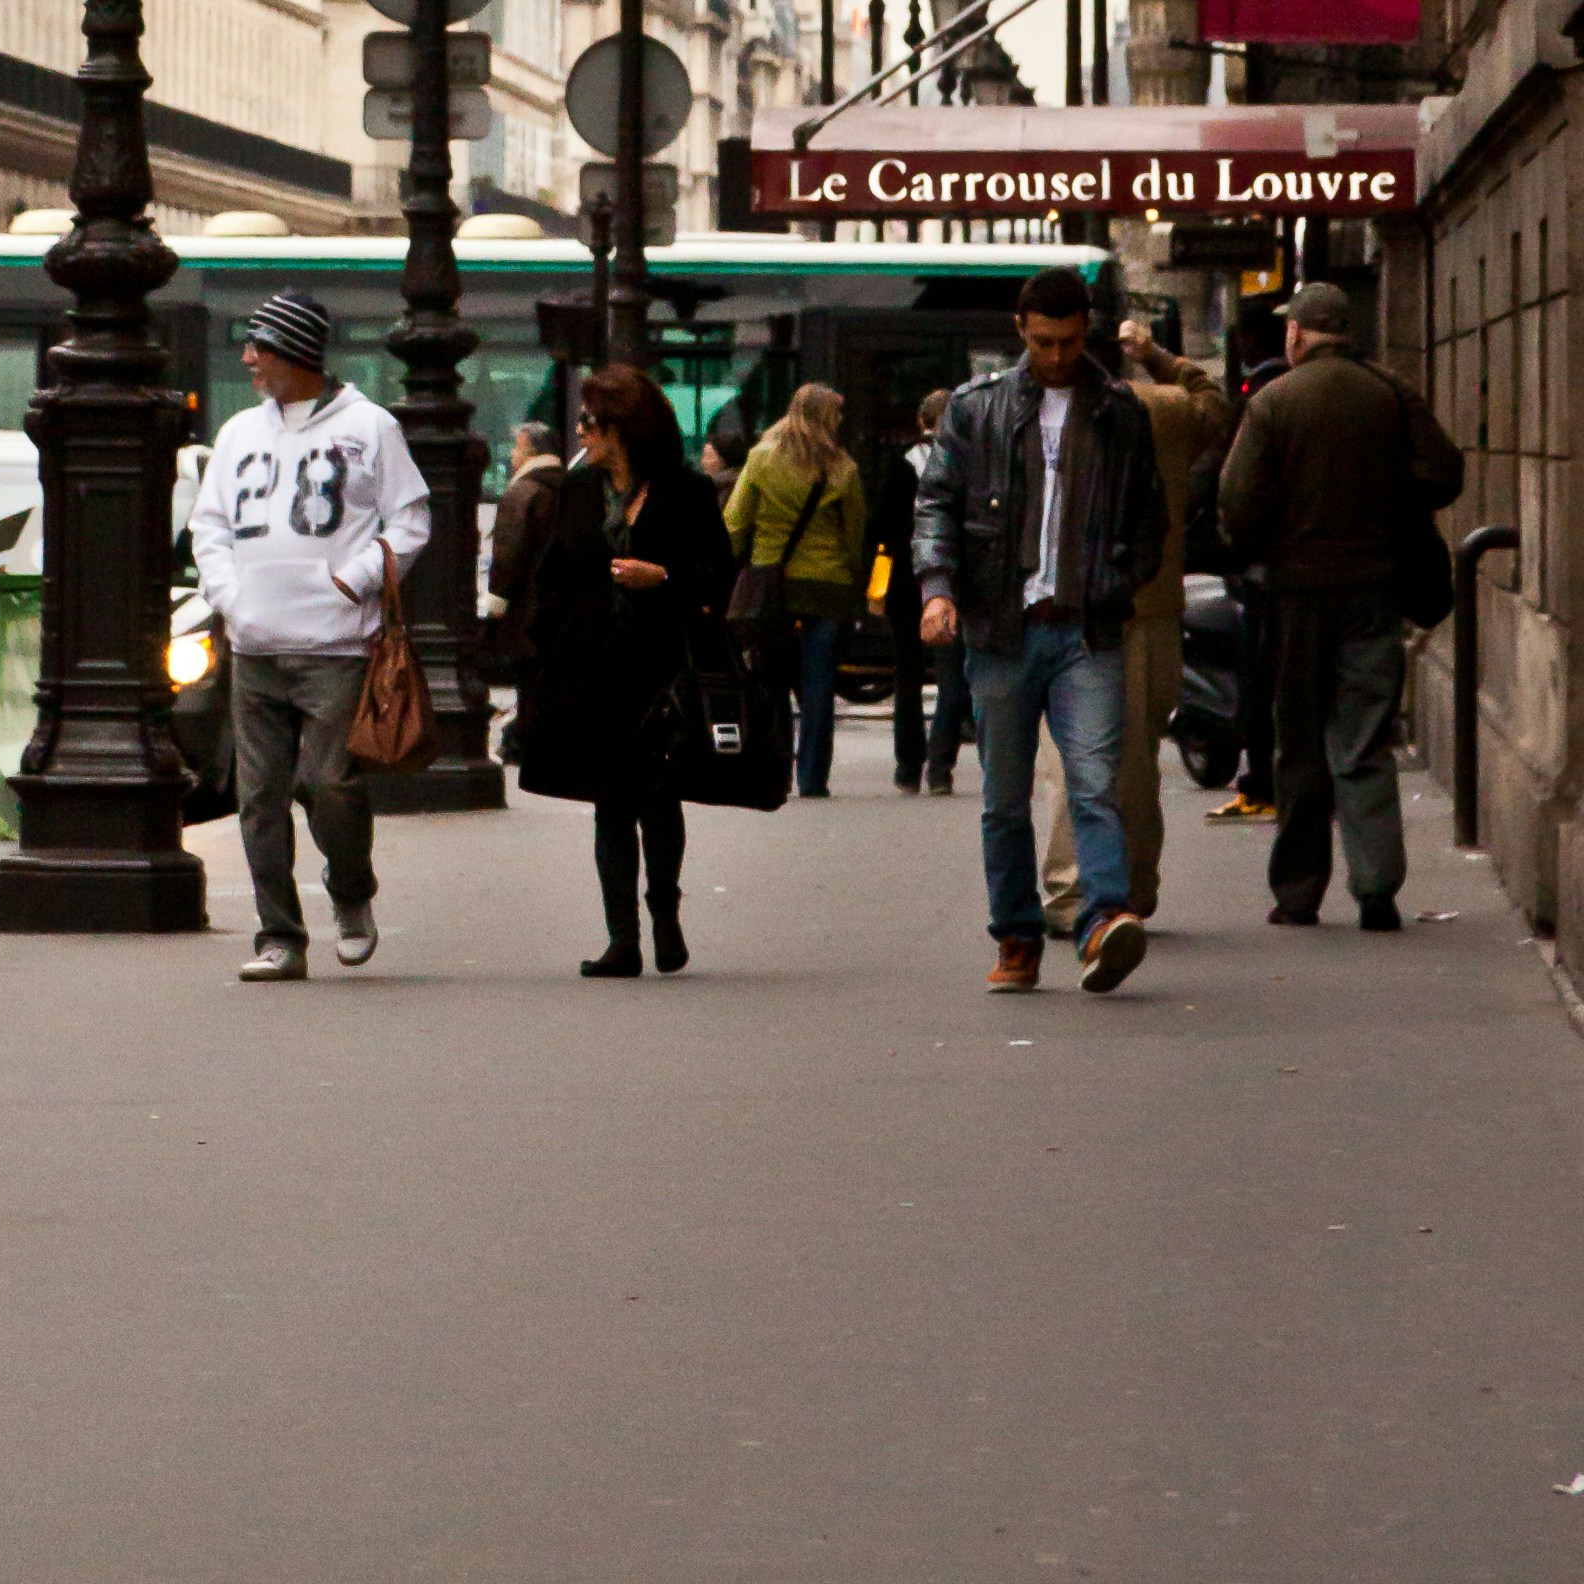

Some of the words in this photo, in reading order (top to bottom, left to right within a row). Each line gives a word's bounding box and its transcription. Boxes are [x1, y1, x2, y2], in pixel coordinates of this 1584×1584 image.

[788, 159, 847, 201] Le
[868, 158, 1111, 202] Carrousel
[1132, 158, 1195, 201] du
[1217, 158, 1396, 202] Louvre
[234, 447, 348, 540] 28
